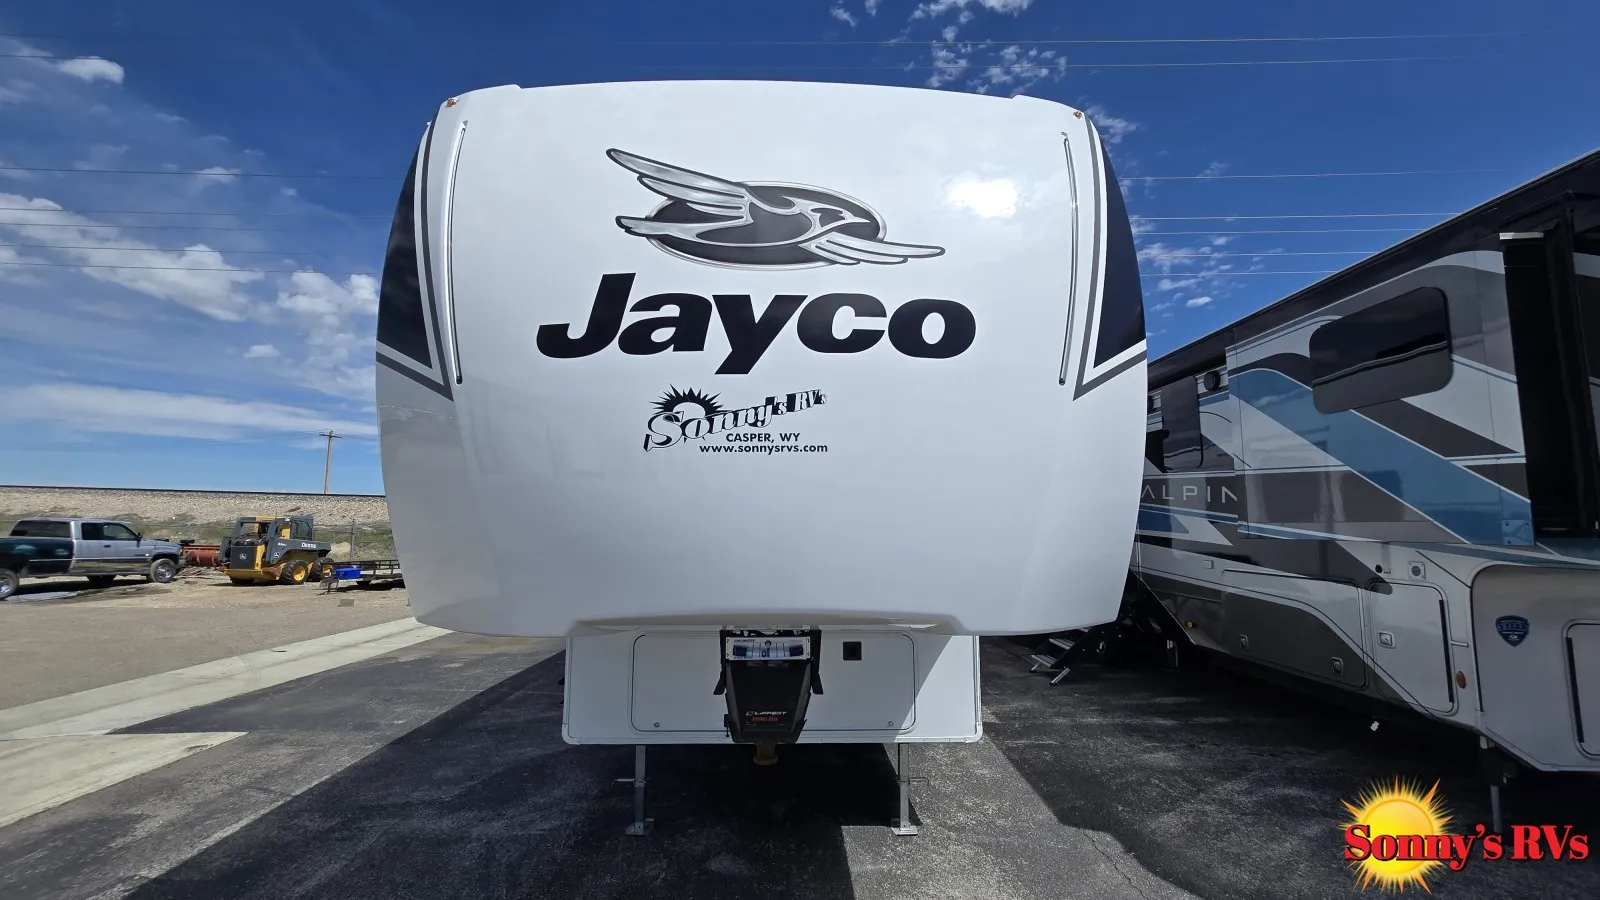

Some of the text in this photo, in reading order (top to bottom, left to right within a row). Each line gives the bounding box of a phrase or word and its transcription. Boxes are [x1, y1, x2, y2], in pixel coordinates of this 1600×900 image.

[536, 272, 976, 374] Jayco
[643, 389, 827, 452] Sonny's RV's
[726, 433, 801, 443] CASPER, WY
[699, 444, 828, 455] www.sonnysrvs.com
